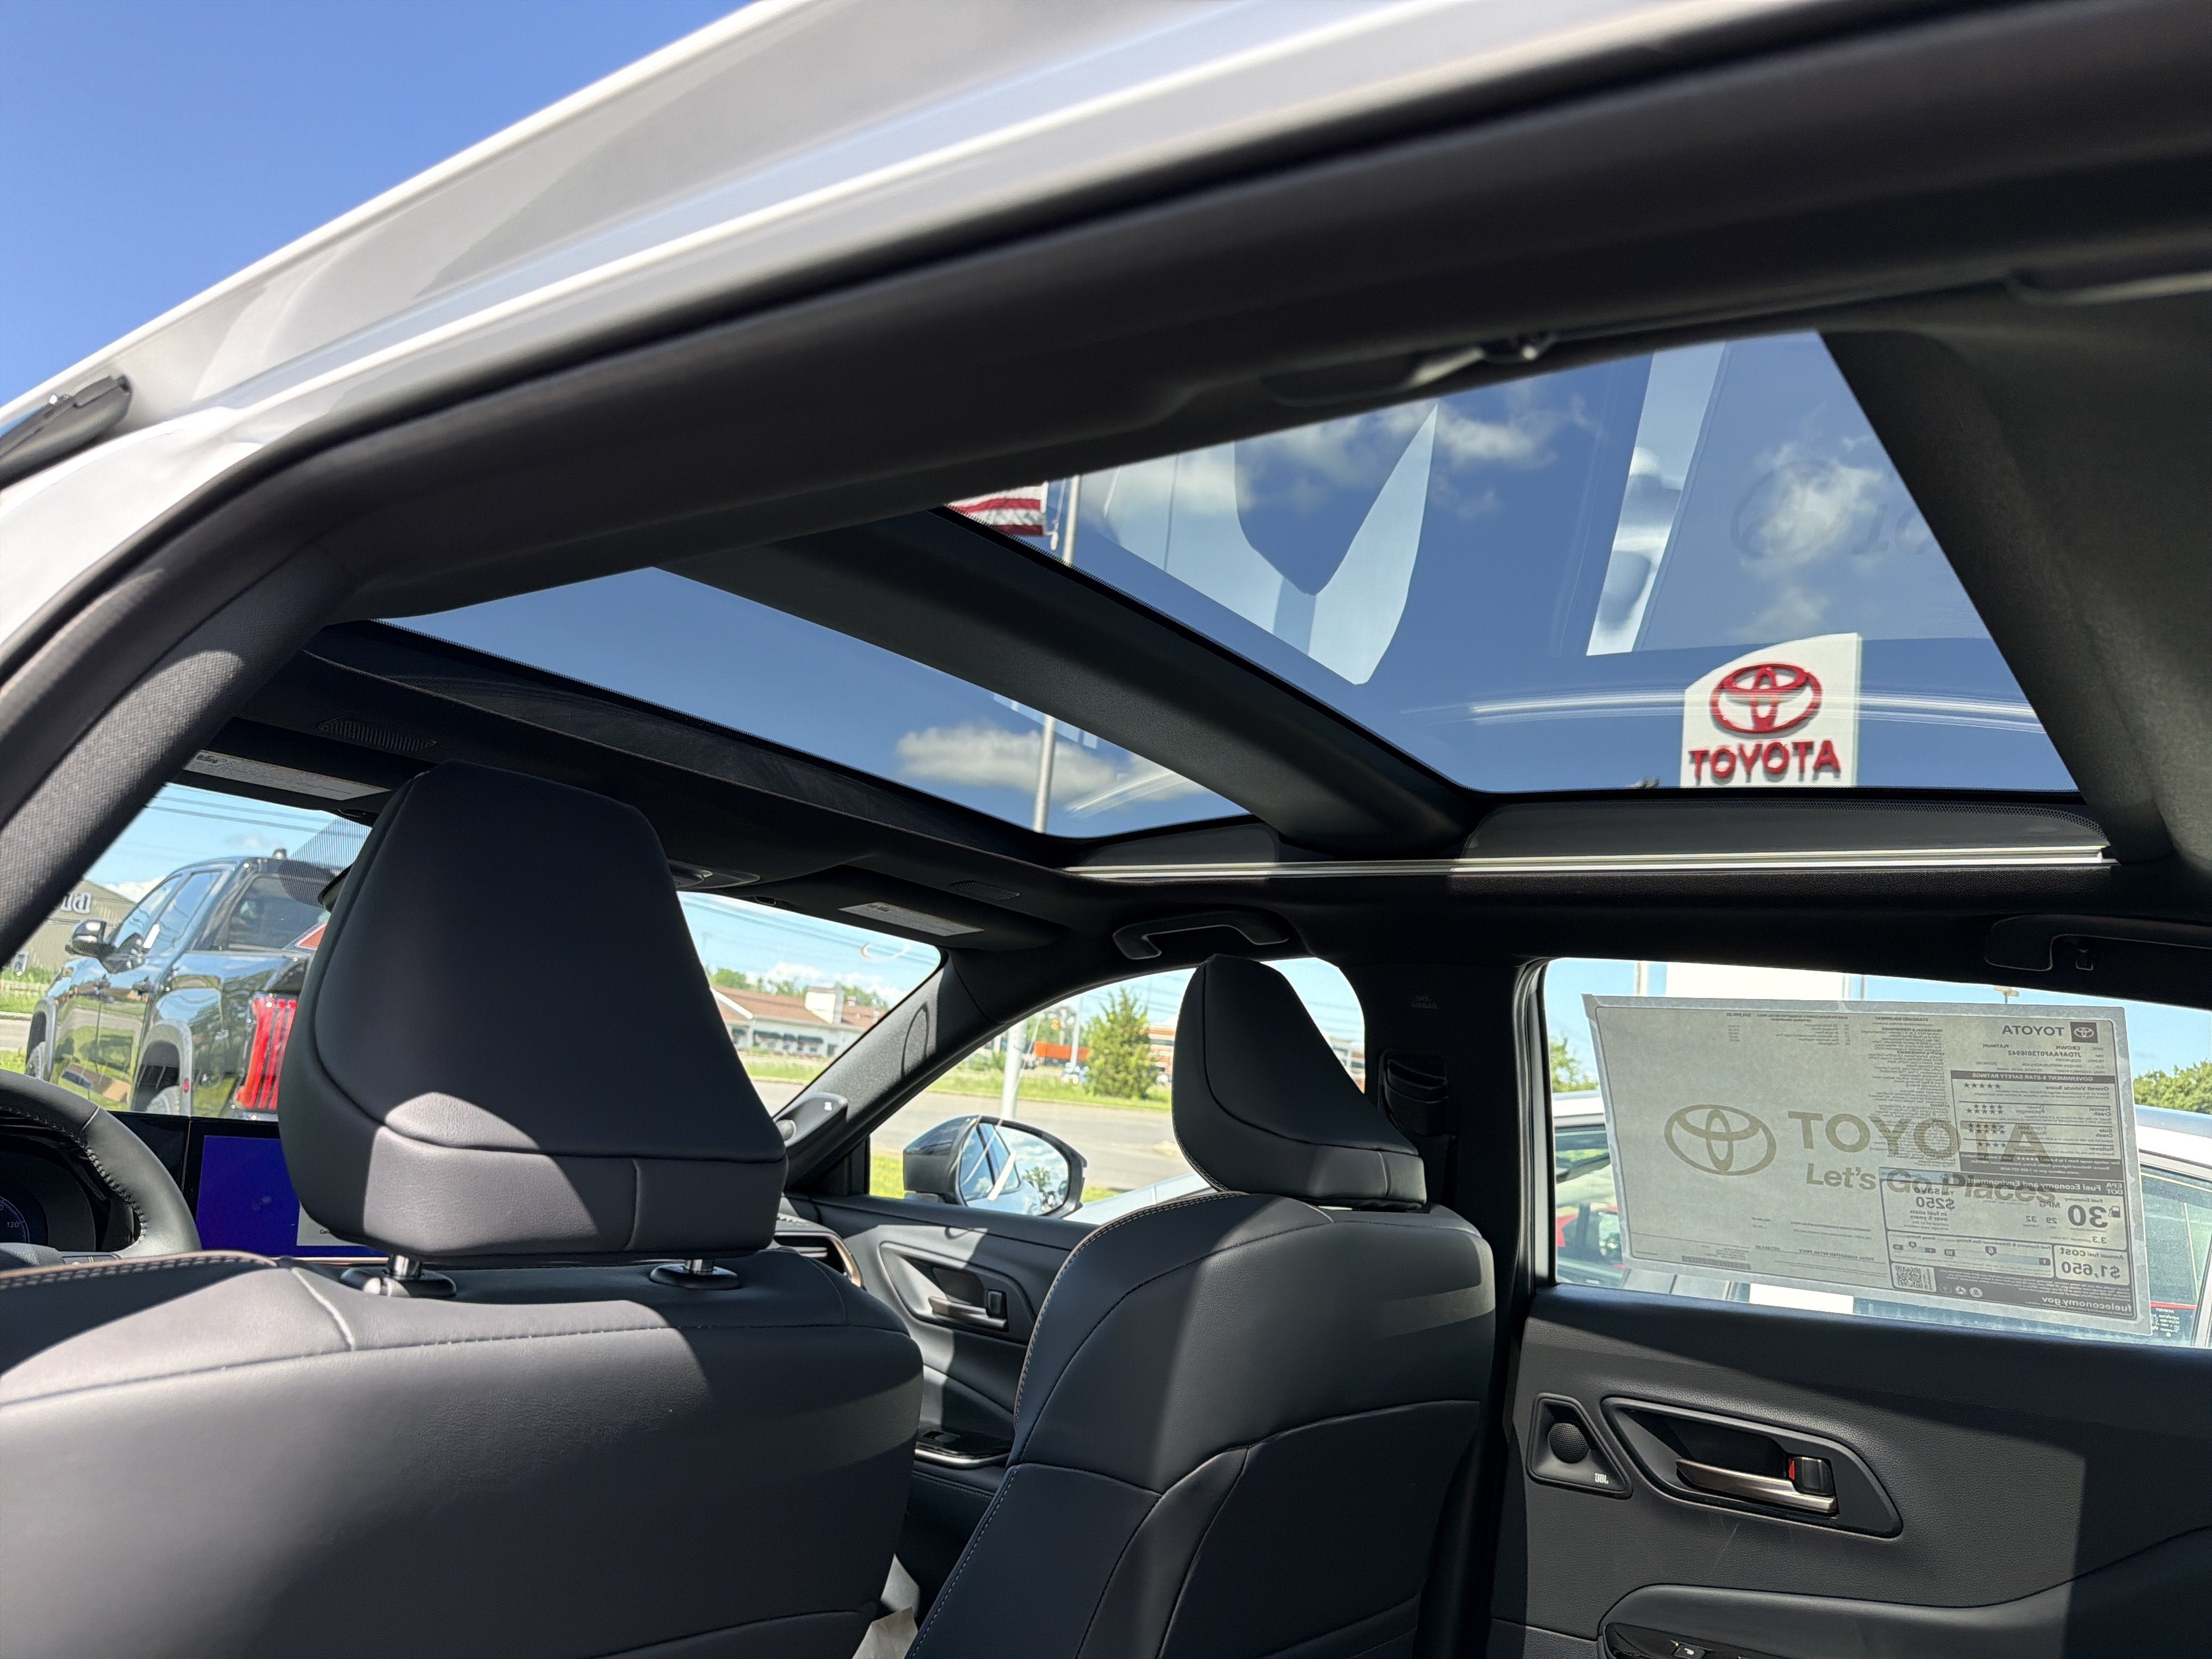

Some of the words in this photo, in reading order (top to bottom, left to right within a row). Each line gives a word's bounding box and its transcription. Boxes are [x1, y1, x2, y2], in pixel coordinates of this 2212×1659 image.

[1689, 739, 1840, 778] TOYOTA
[1788, 1111, 2053, 1164] TOYOTA
[1805, 1163, 1876, 1190] Let's
[1942, 1172, 2056, 1203] Places
[1595, 1473, 1609, 1484] JBL
